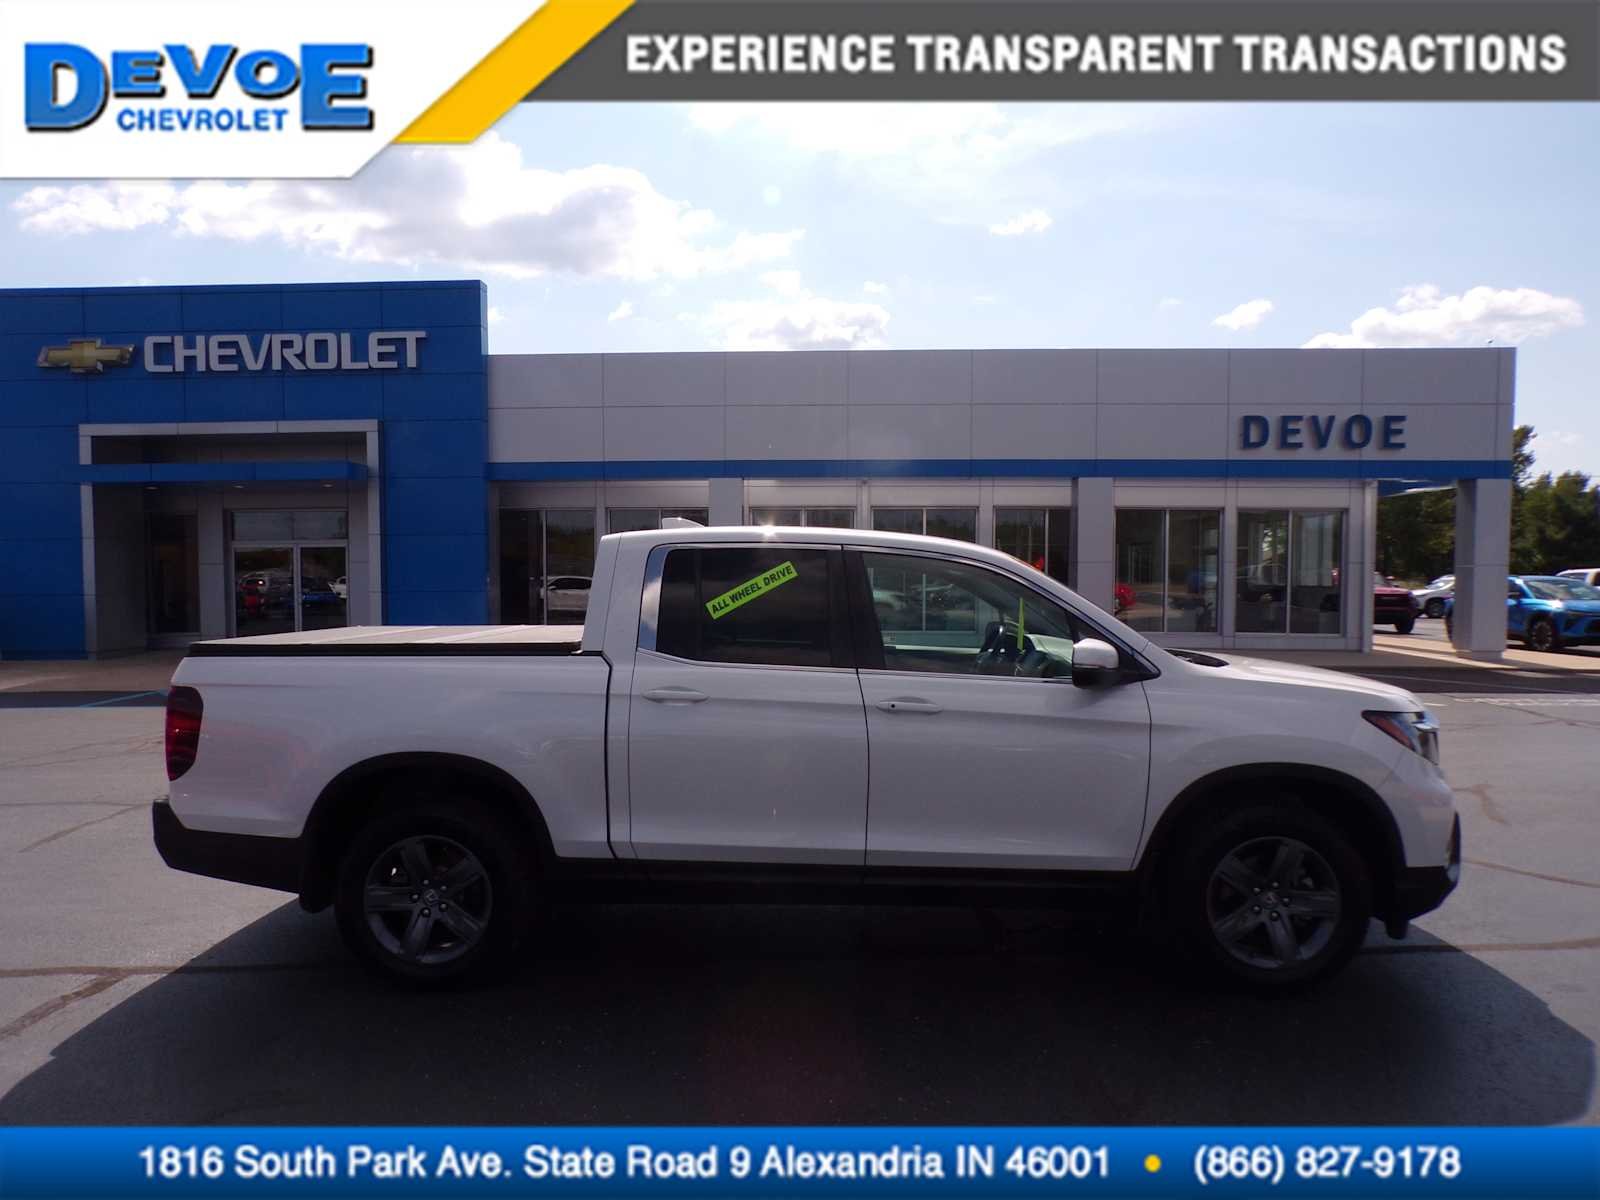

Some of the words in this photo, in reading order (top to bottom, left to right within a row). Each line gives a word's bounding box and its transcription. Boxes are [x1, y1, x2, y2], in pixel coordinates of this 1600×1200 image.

[143, 330, 426, 374] CHEVROLET
[1240, 413, 1407, 452] DEVOE
[711, 599, 730, 614] ALL
[728, 582, 763, 604] WHEEL
[763, 564, 793, 586] DRIVE
